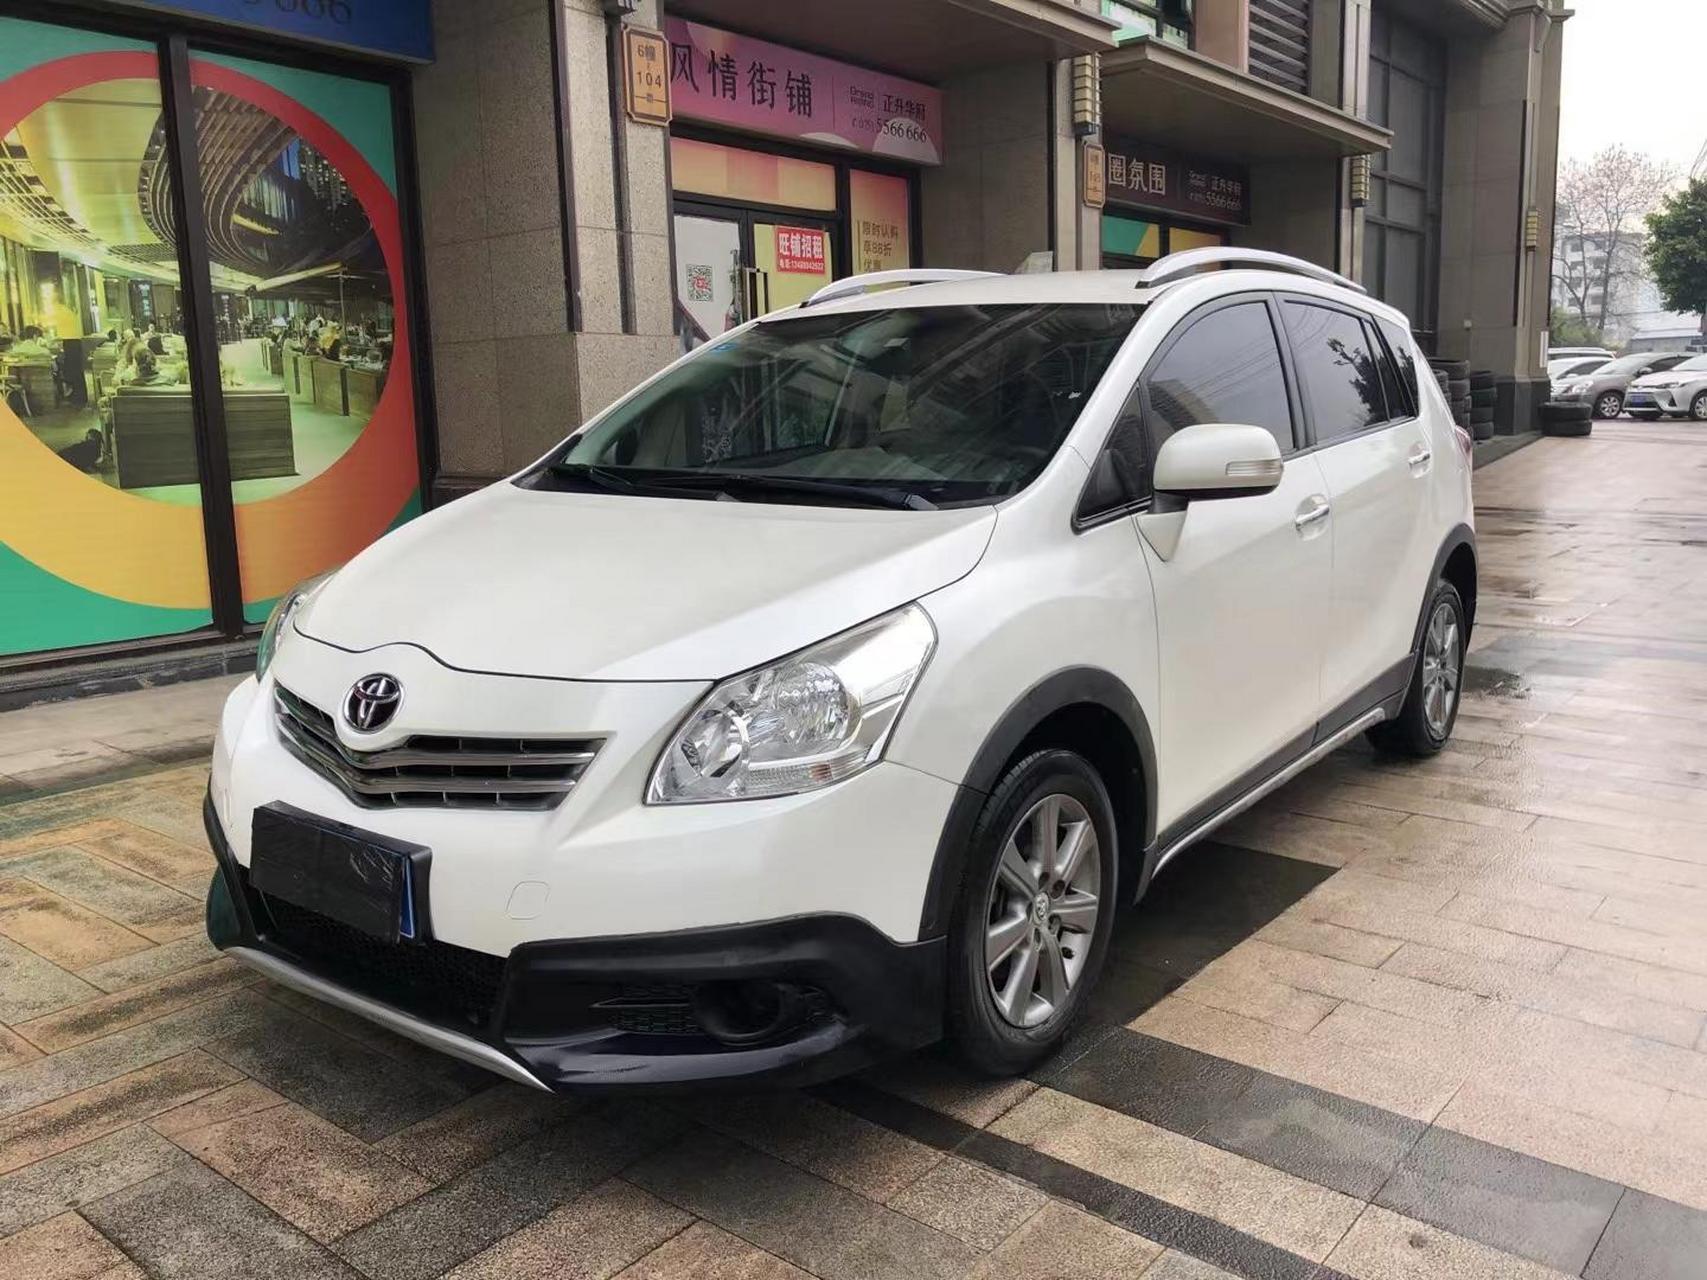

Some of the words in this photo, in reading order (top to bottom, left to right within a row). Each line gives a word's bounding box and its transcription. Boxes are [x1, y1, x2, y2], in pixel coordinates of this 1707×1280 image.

[636, 71, 662, 88] 104
[670, 42, 812, 117] 风情街铺
[1108, 153, 1166, 195] 圈氛围
[779, 232, 823, 258] 旺铺招租
